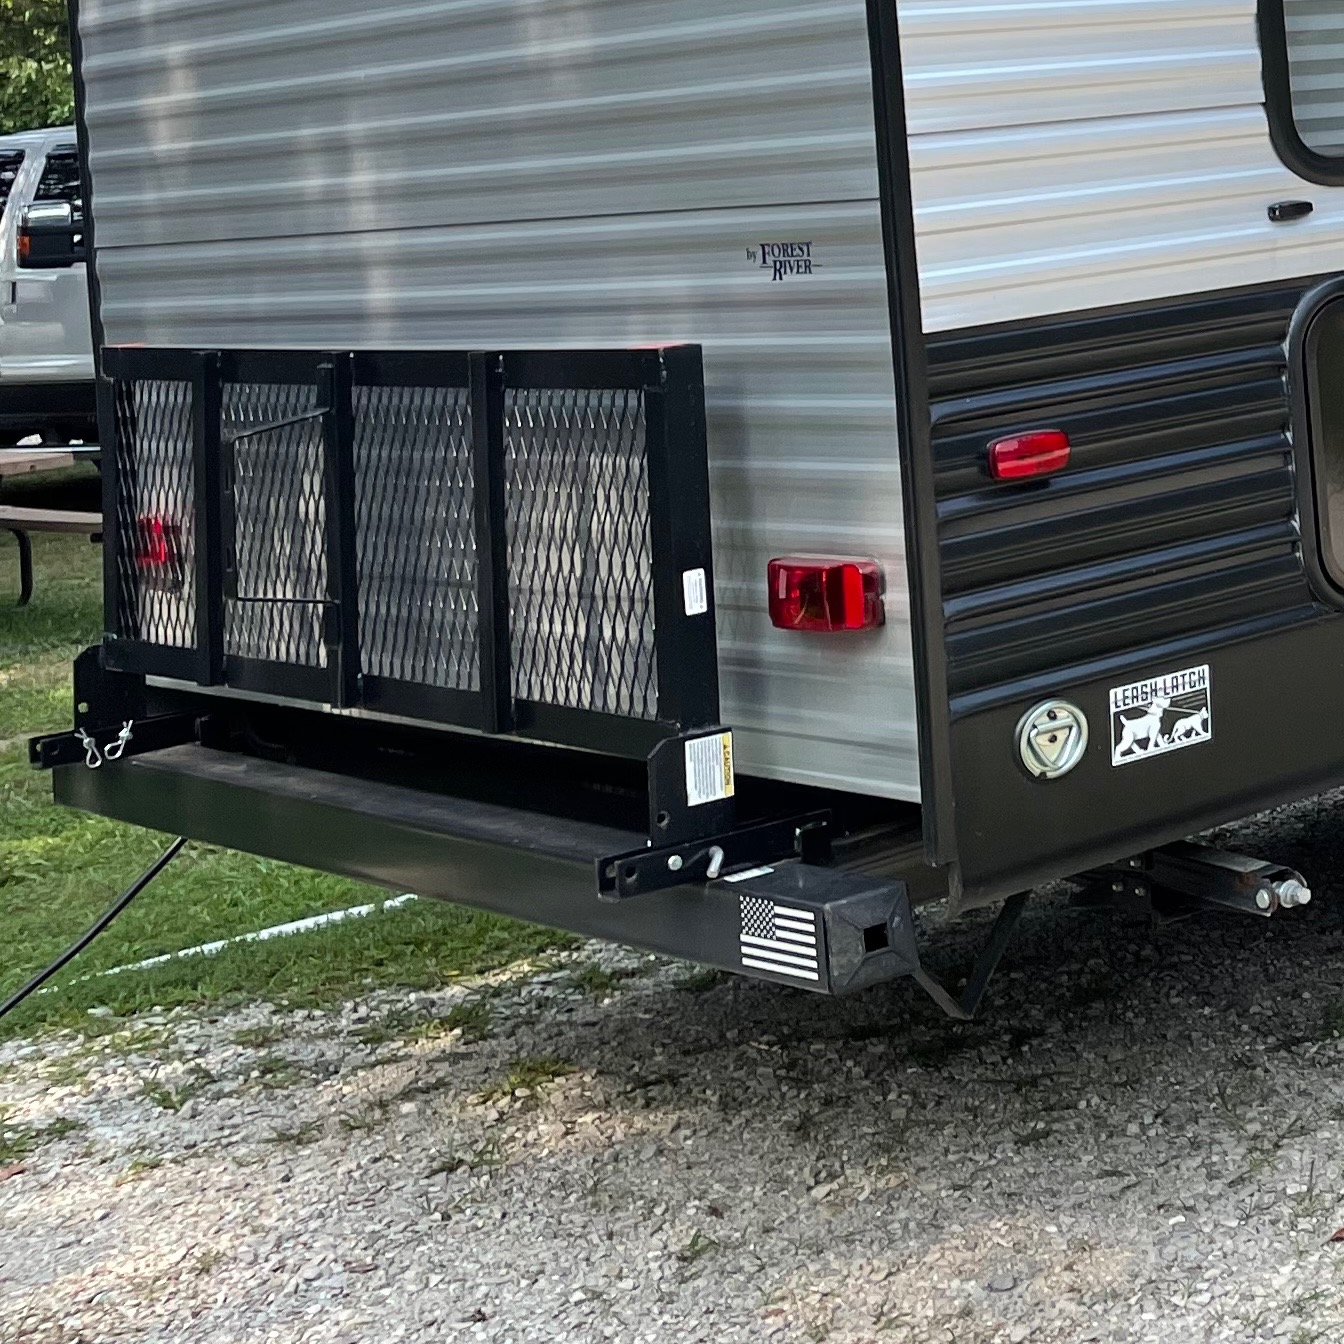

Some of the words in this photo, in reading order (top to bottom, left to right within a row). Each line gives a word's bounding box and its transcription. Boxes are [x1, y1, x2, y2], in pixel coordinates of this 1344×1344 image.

[745, 247, 758, 264] by
[759, 240, 813, 265] FOREST
[772, 258, 814, 282] RIVER
